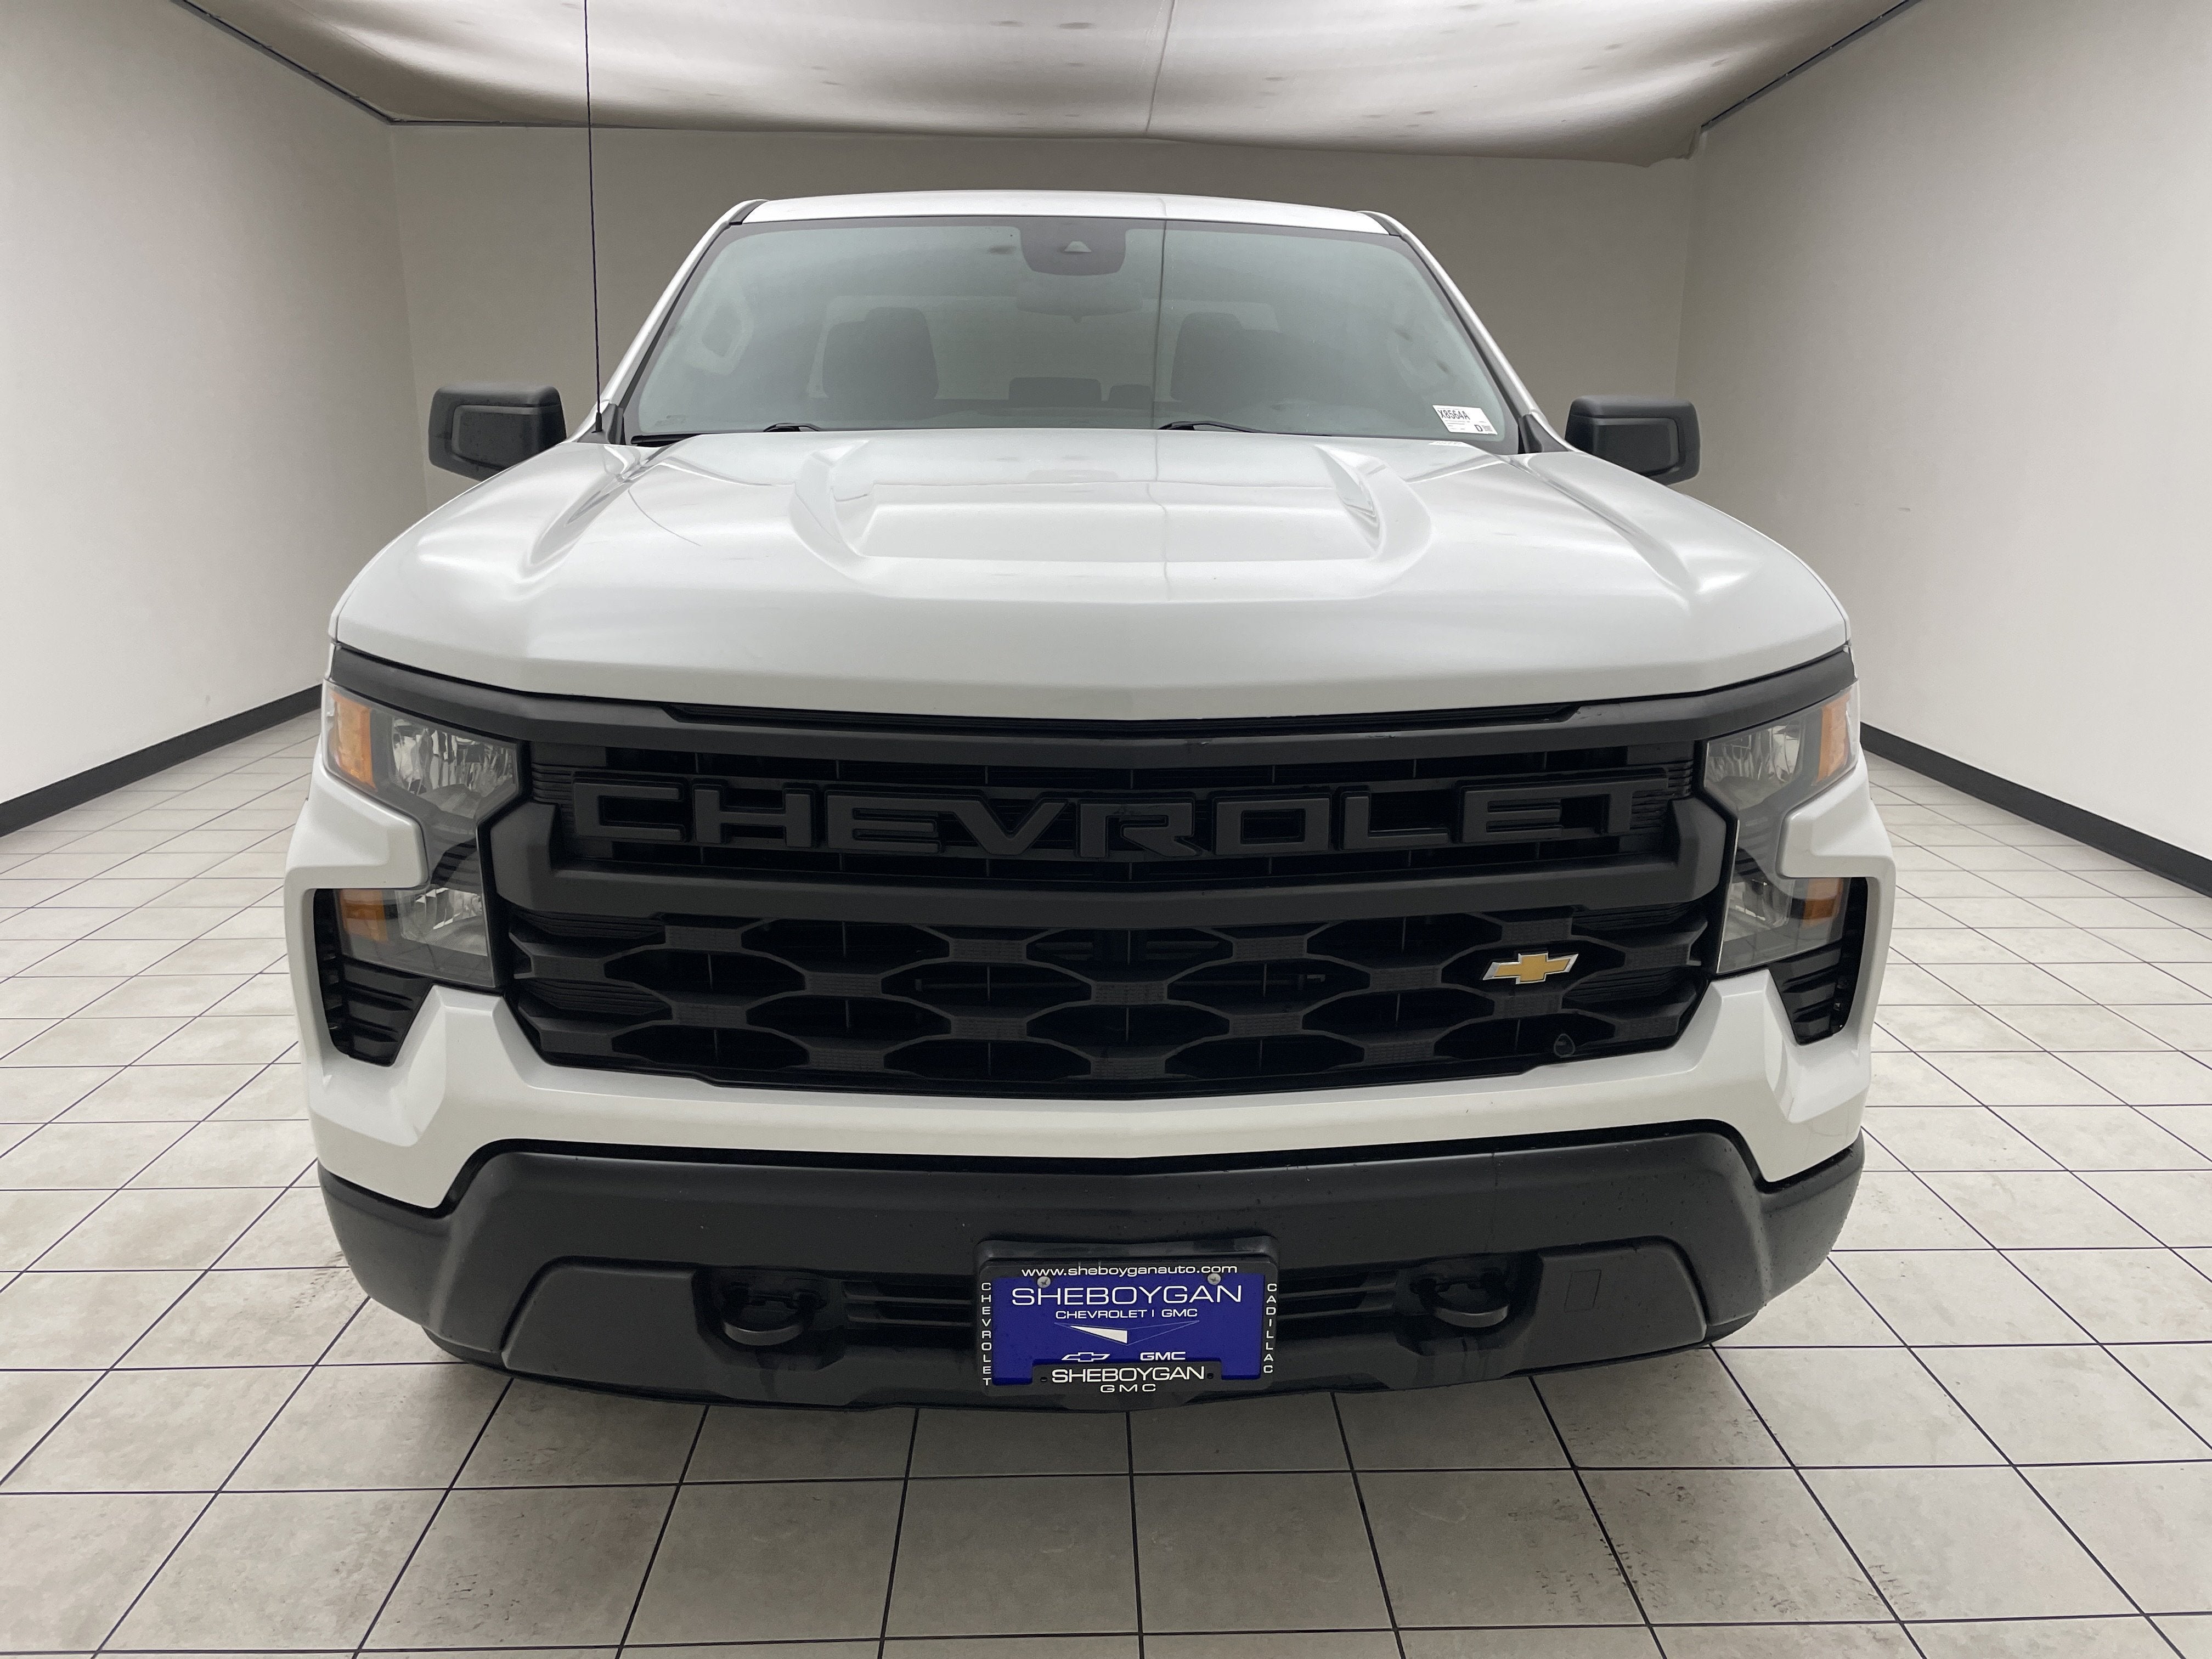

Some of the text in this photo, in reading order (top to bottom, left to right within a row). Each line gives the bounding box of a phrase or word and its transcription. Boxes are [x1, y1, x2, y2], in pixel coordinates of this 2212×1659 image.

[573, 777, 1668, 858] CHEVROLET
[1021, 1266, 1238, 1277] www.sheboyganauto.com
[1012, 1285, 1242, 1306] SHEBOYGAN
[1056, 1309, 1148, 1319] CHEVROLET
[1161, 1308, 1198, 1317] GMC
[981, 1283, 992, 1386] CHEVROLET
[1263, 1283, 1277, 1374] CADILLAC
[1139, 1351, 1186, 1361] GMC
[1052, 1366, 1205, 1383] SHEBOYGAN
[1100, 1384, 1156, 1393] GMC
